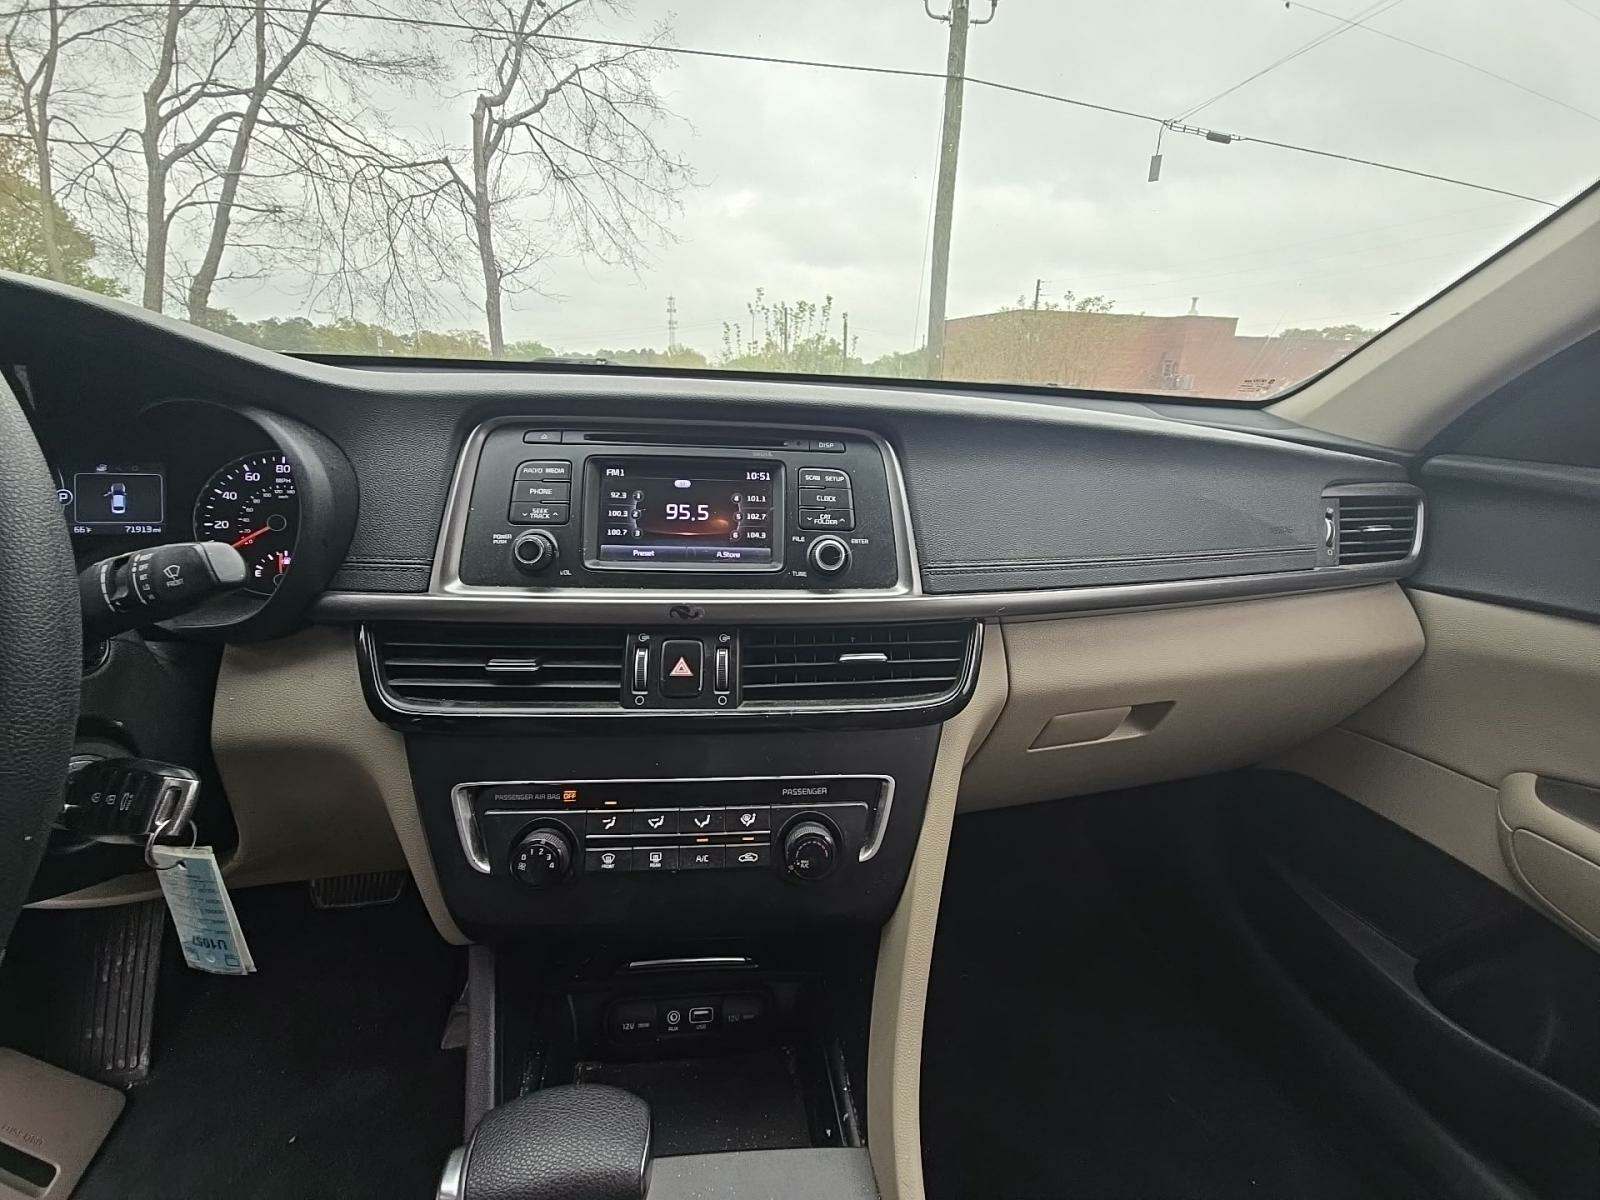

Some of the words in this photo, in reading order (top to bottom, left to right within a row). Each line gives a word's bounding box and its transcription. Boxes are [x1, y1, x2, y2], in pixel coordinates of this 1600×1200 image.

[275, 465, 291, 473] 80
[606, 469, 625, 477] FM1
[245, 473, 261, 482] 60
[746, 472, 771, 481] 10:51
[58, 492, 69, 503] P
[222, 491, 238, 500] 40
[610, 491, 628, 499] 92.3
[665, 503, 710, 522] 95.5
[214, 520, 230, 529] 20
[814, 518, 838, 526] FOLDER
[494, 793, 534, 801] PASSENGER
[563, 791, 577, 800] OFF
[782, 787, 828, 796] PASSENGER
